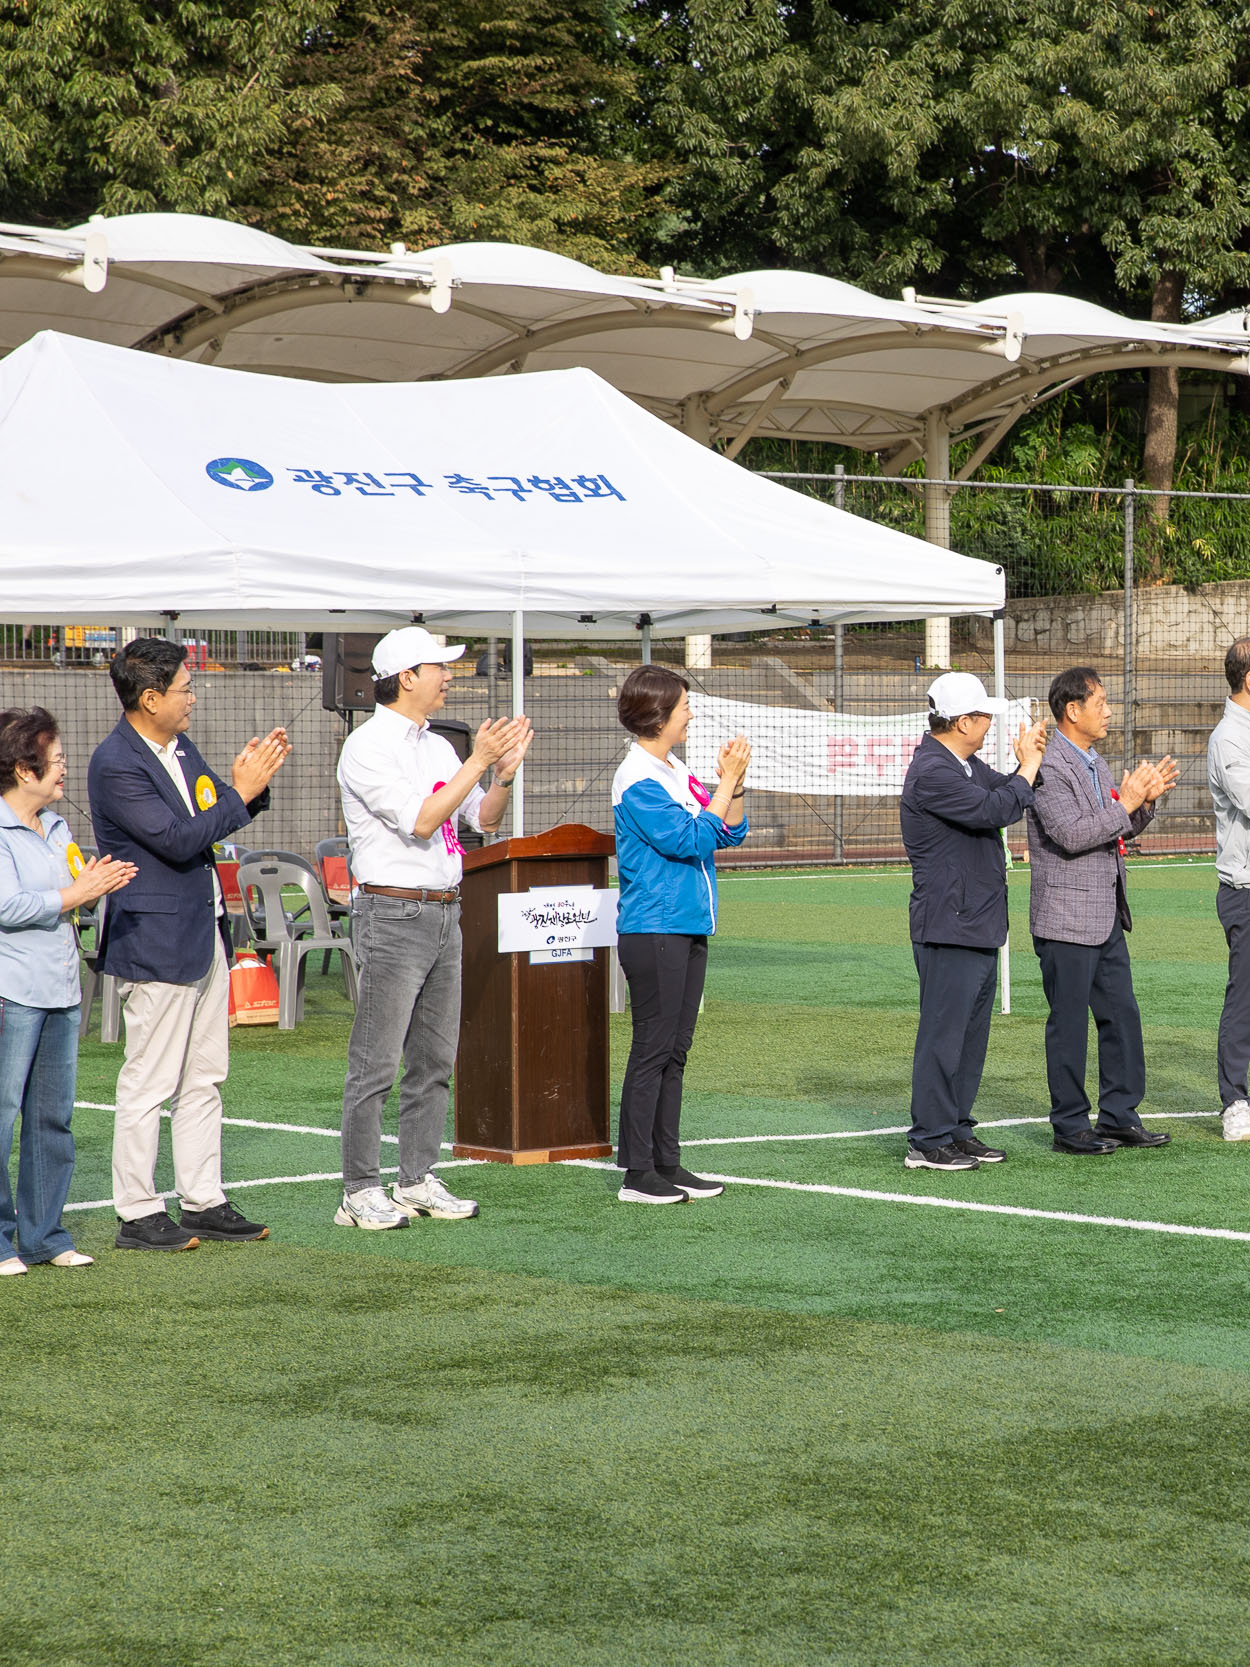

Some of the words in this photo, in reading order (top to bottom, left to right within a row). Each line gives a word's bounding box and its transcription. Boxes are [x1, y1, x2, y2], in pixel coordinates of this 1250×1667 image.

[285, 467, 433, 496] 광진구
[443, 473, 628, 503] 축구협회
[557, 935, 577, 944] 광진구
[551, 948, 572, 958] GJFA
